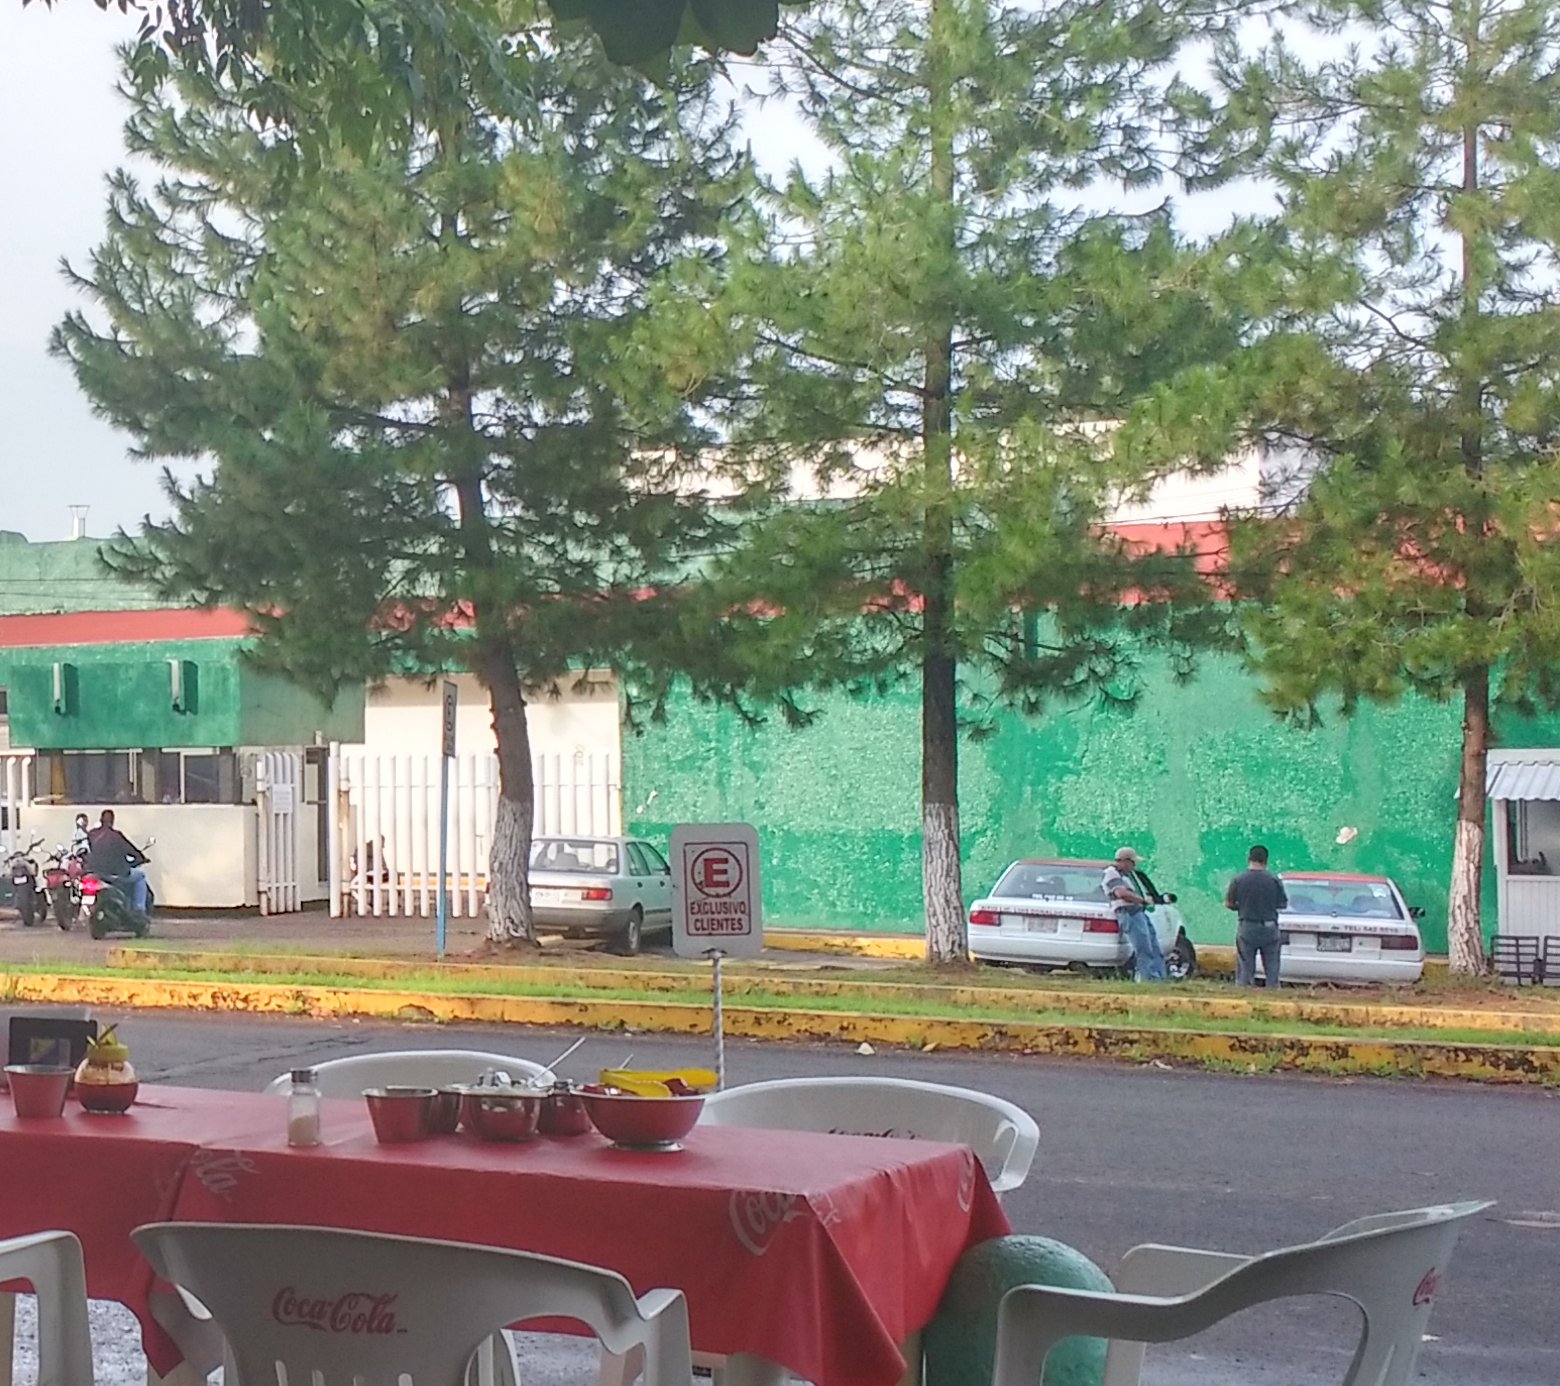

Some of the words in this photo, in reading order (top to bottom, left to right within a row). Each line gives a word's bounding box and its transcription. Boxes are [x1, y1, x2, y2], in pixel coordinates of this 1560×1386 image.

[703, 857, 730, 888] E
[690, 900, 746, 916] EXCLUSIVO
[694, 917, 744, 932] CLIENTES
[271, 1286, 398, 1335] Coca-Cola
